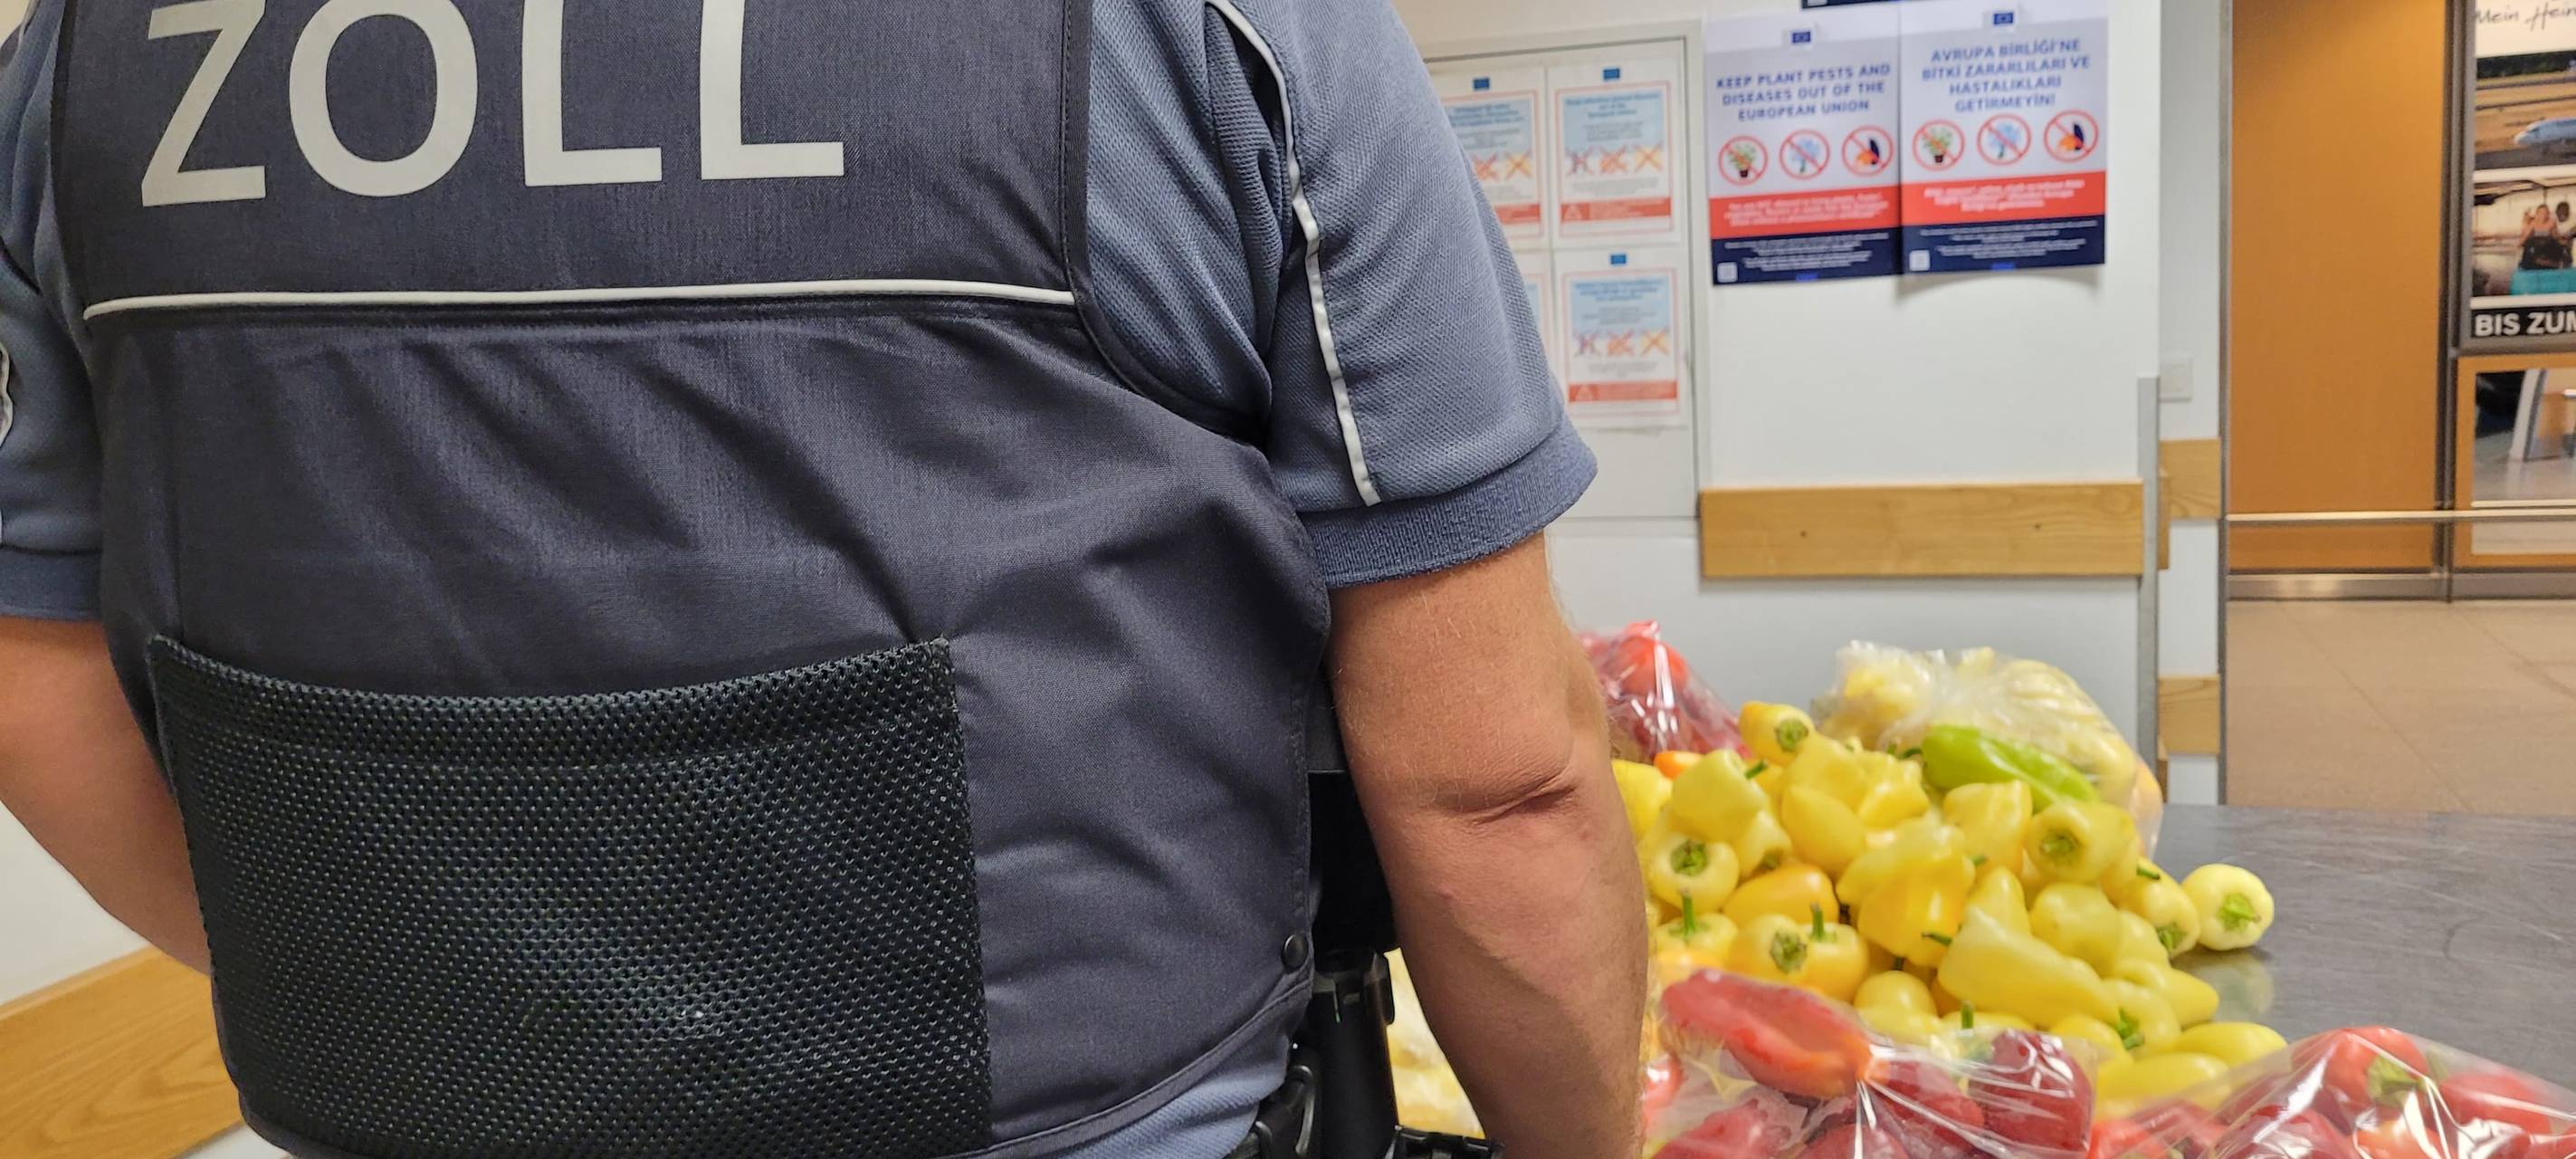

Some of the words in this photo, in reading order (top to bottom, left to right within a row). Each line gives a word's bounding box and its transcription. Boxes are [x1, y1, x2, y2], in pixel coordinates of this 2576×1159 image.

[1931, 47, 1995, 62] AVRUPA
[1965, 58, 2066, 78] ZARARLILARI
[2070, 55, 2091, 70] VE
[1716, 75, 1752, 89] KEEP
[1757, 71, 1802, 85] PLANT
[1808, 66, 1854, 81] PESTS
[1858, 63, 1891, 76] AND
[1950, 76, 2062, 95] HASTALIKLARI
[141, 0, 844, 207] ZOLL
[1722, 91, 1792, 106] DISEASES
[1797, 86, 1827, 100] OUT
[1832, 83, 1851, 94] OF
[1858, 81, 1884, 93] THE
[1738, 106, 1816, 121] EUROPEAN
[1821, 101, 1869, 114] UNION
[2475, 312, 2521, 337] BIS
